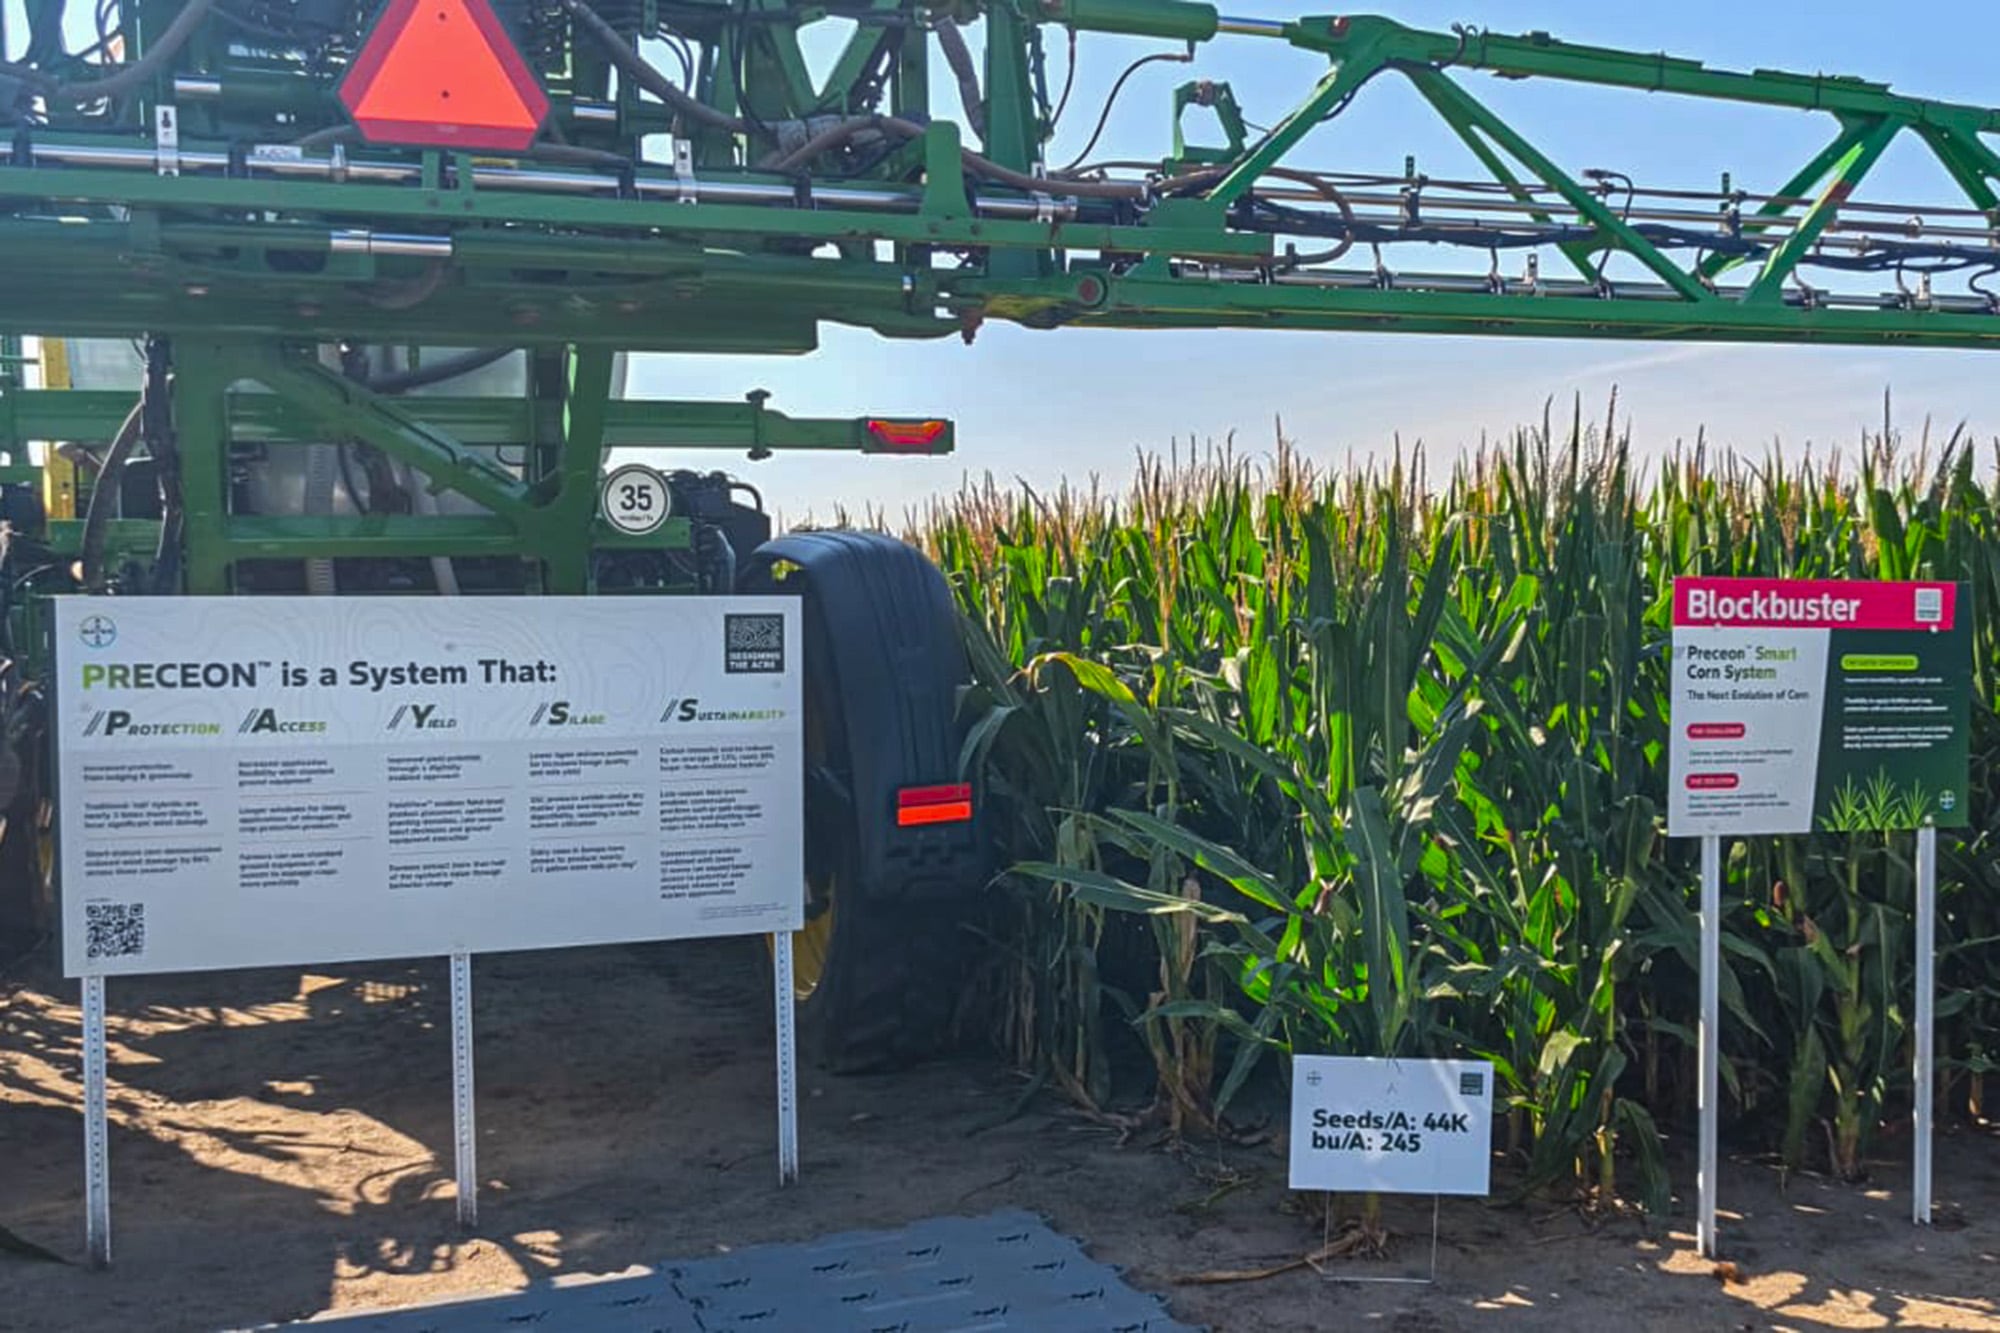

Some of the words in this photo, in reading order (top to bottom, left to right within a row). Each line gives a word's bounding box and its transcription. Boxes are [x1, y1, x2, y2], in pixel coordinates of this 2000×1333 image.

[620, 484, 652, 511] 35
[1687, 589, 1861, 621] Blockbuster
[1755, 646, 1797, 661] Smart
[281, 661, 308, 687] is
[319, 666, 338, 687] a
[349, 661, 468, 692] System
[478, 659, 557, 684] That:
[1686, 664, 1720, 679] Corn
[1724, 664, 1777, 682] System
[1687, 689, 1705, 700] The
[1707, 689, 1730, 700] Next
[1731, 689, 1774, 700] Evolution
[1776, 689, 1787, 700] of
[1787, 689, 1810, 700] Corn
[1312, 1109, 1417, 1130] Seeds/A:
[1423, 1112, 1468, 1133] 44K
[1312, 1131, 1373, 1151] bu/A:
[1380, 1133, 1421, 1152] 245
